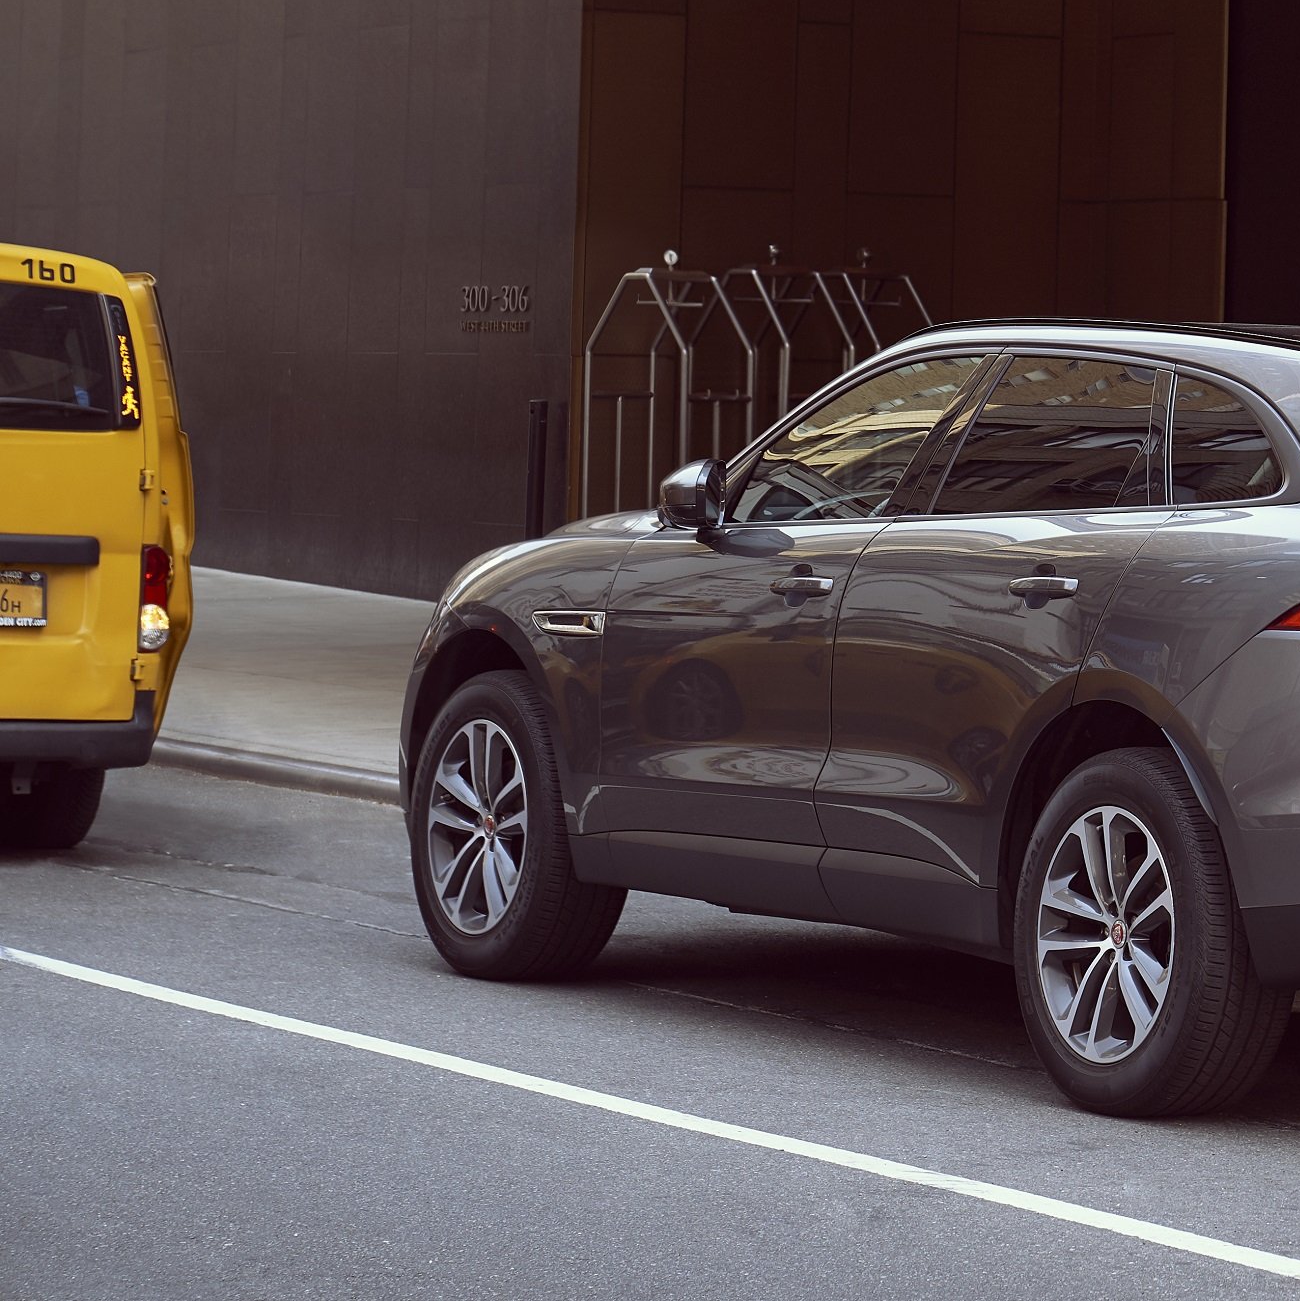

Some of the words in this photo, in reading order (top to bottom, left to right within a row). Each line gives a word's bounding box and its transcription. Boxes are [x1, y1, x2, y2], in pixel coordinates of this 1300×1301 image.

[460, 285, 489, 312] 300
[500, 285, 529, 312] 306
[117, 334, 133, 382] VACANT
